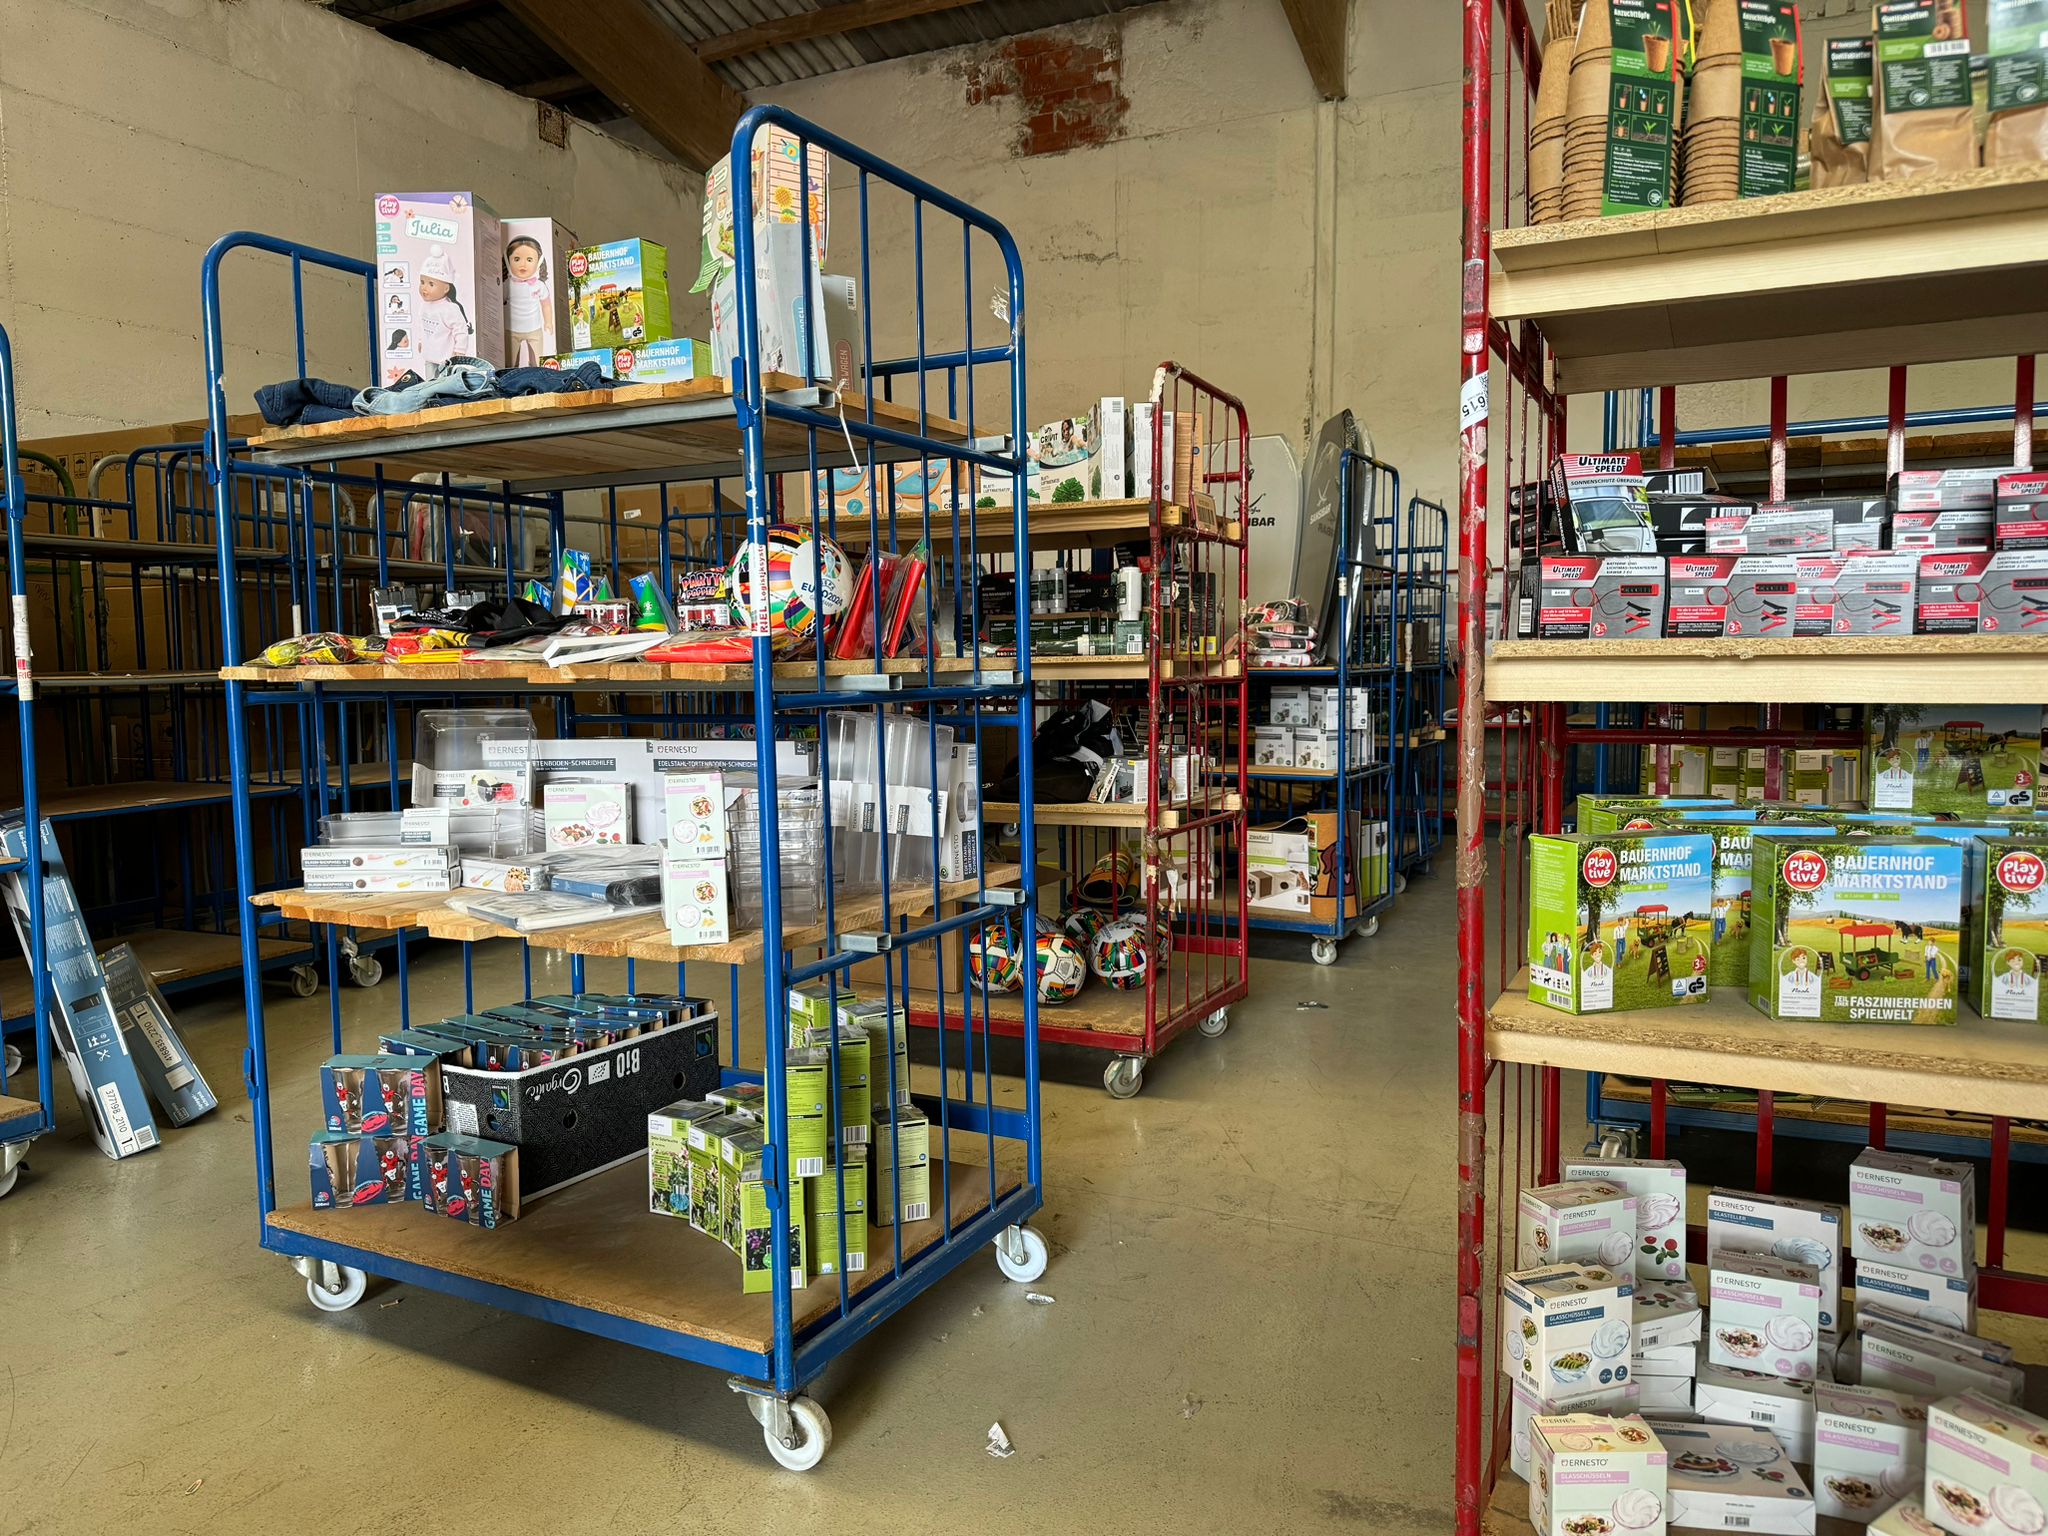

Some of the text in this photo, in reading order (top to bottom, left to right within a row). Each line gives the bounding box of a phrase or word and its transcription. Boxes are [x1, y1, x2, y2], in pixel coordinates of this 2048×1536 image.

[380, 200, 397, 209] Play
[411, 219, 453, 238] Julia
[588, 247, 629, 262] BAUERNHOF
[572, 259, 584, 267] Play
[588, 257, 635, 272] MARKTSTAND
[617, 354, 632, 363] Play
[635, 345, 680, 359] BAUERNHOF
[617, 361, 631, 369] tive
[636, 356, 687, 369] MARKTSTAND
[1041, 433, 1058, 444] CRIVIT
[1578, 456, 1627, 466] ULTIMATE
[1595, 465, 1623, 473] SPEED
[682, 572, 721, 589] PARTY
[801, 582, 844, 607] EUO2024
[1730, 624, 1736, 632] 3
[1984, 619, 1990, 628] 3
[664, 745, 698, 754] ERNESTO
[2017, 774, 2024, 782] 3
[2009, 791, 2031, 805] GS
[1620, 846, 1693, 864] BAUERNHOF
[1588, 859, 1612, 871] Play
[1789, 860, 1822, 873] Play
[1835, 855, 1935, 871] BAUERNHOF
[2004, 862, 2039, 875] Play
[1588, 868, 1611, 879] tive
[1620, 863, 1701, 881] MARKTSTAND
[1790, 871, 1820, 883] tive
[2004, 872, 2037, 884] tive
[1835, 874, 1948, 890] MARKTSTAND
[1694, 960, 1701, 969] 3
[1688, 977, 1705, 993] GS
[1850, 996, 1952, 1010] FASZINIERENDEN
[1850, 1008, 1915, 1021] SPIELWELT
[525, 1067, 582, 1101] Organic
[106, 1089, 128, 1133] 377198_2110
[411, 1072, 428, 1137] GAME DAY
[1578, 1169, 1609, 1177] ERNESTO
[1865, 1172, 1902, 1185] ERNESTO
[480, 1158, 496, 1230] GAME DAY
[1721, 1201, 1755, 1212] ERNESTO
[1569, 1209, 1597, 1220] ERNESTO
[1871, 1267, 1909, 1281] ERNESTO
[1724, 1277, 1762, 1290] ERNESTO
[1557, 1297, 1588, 1309] ERNESTO
[1875, 1344, 1914, 1363] ERNESTO
[1566, 1398, 1597, 1412] ERNESTO
[1833, 1420, 1876, 1435] ERNESTO
[1943, 1418, 1986, 1444] ERNESTO
[1569, 1459, 1608, 1467] ERNESTO
